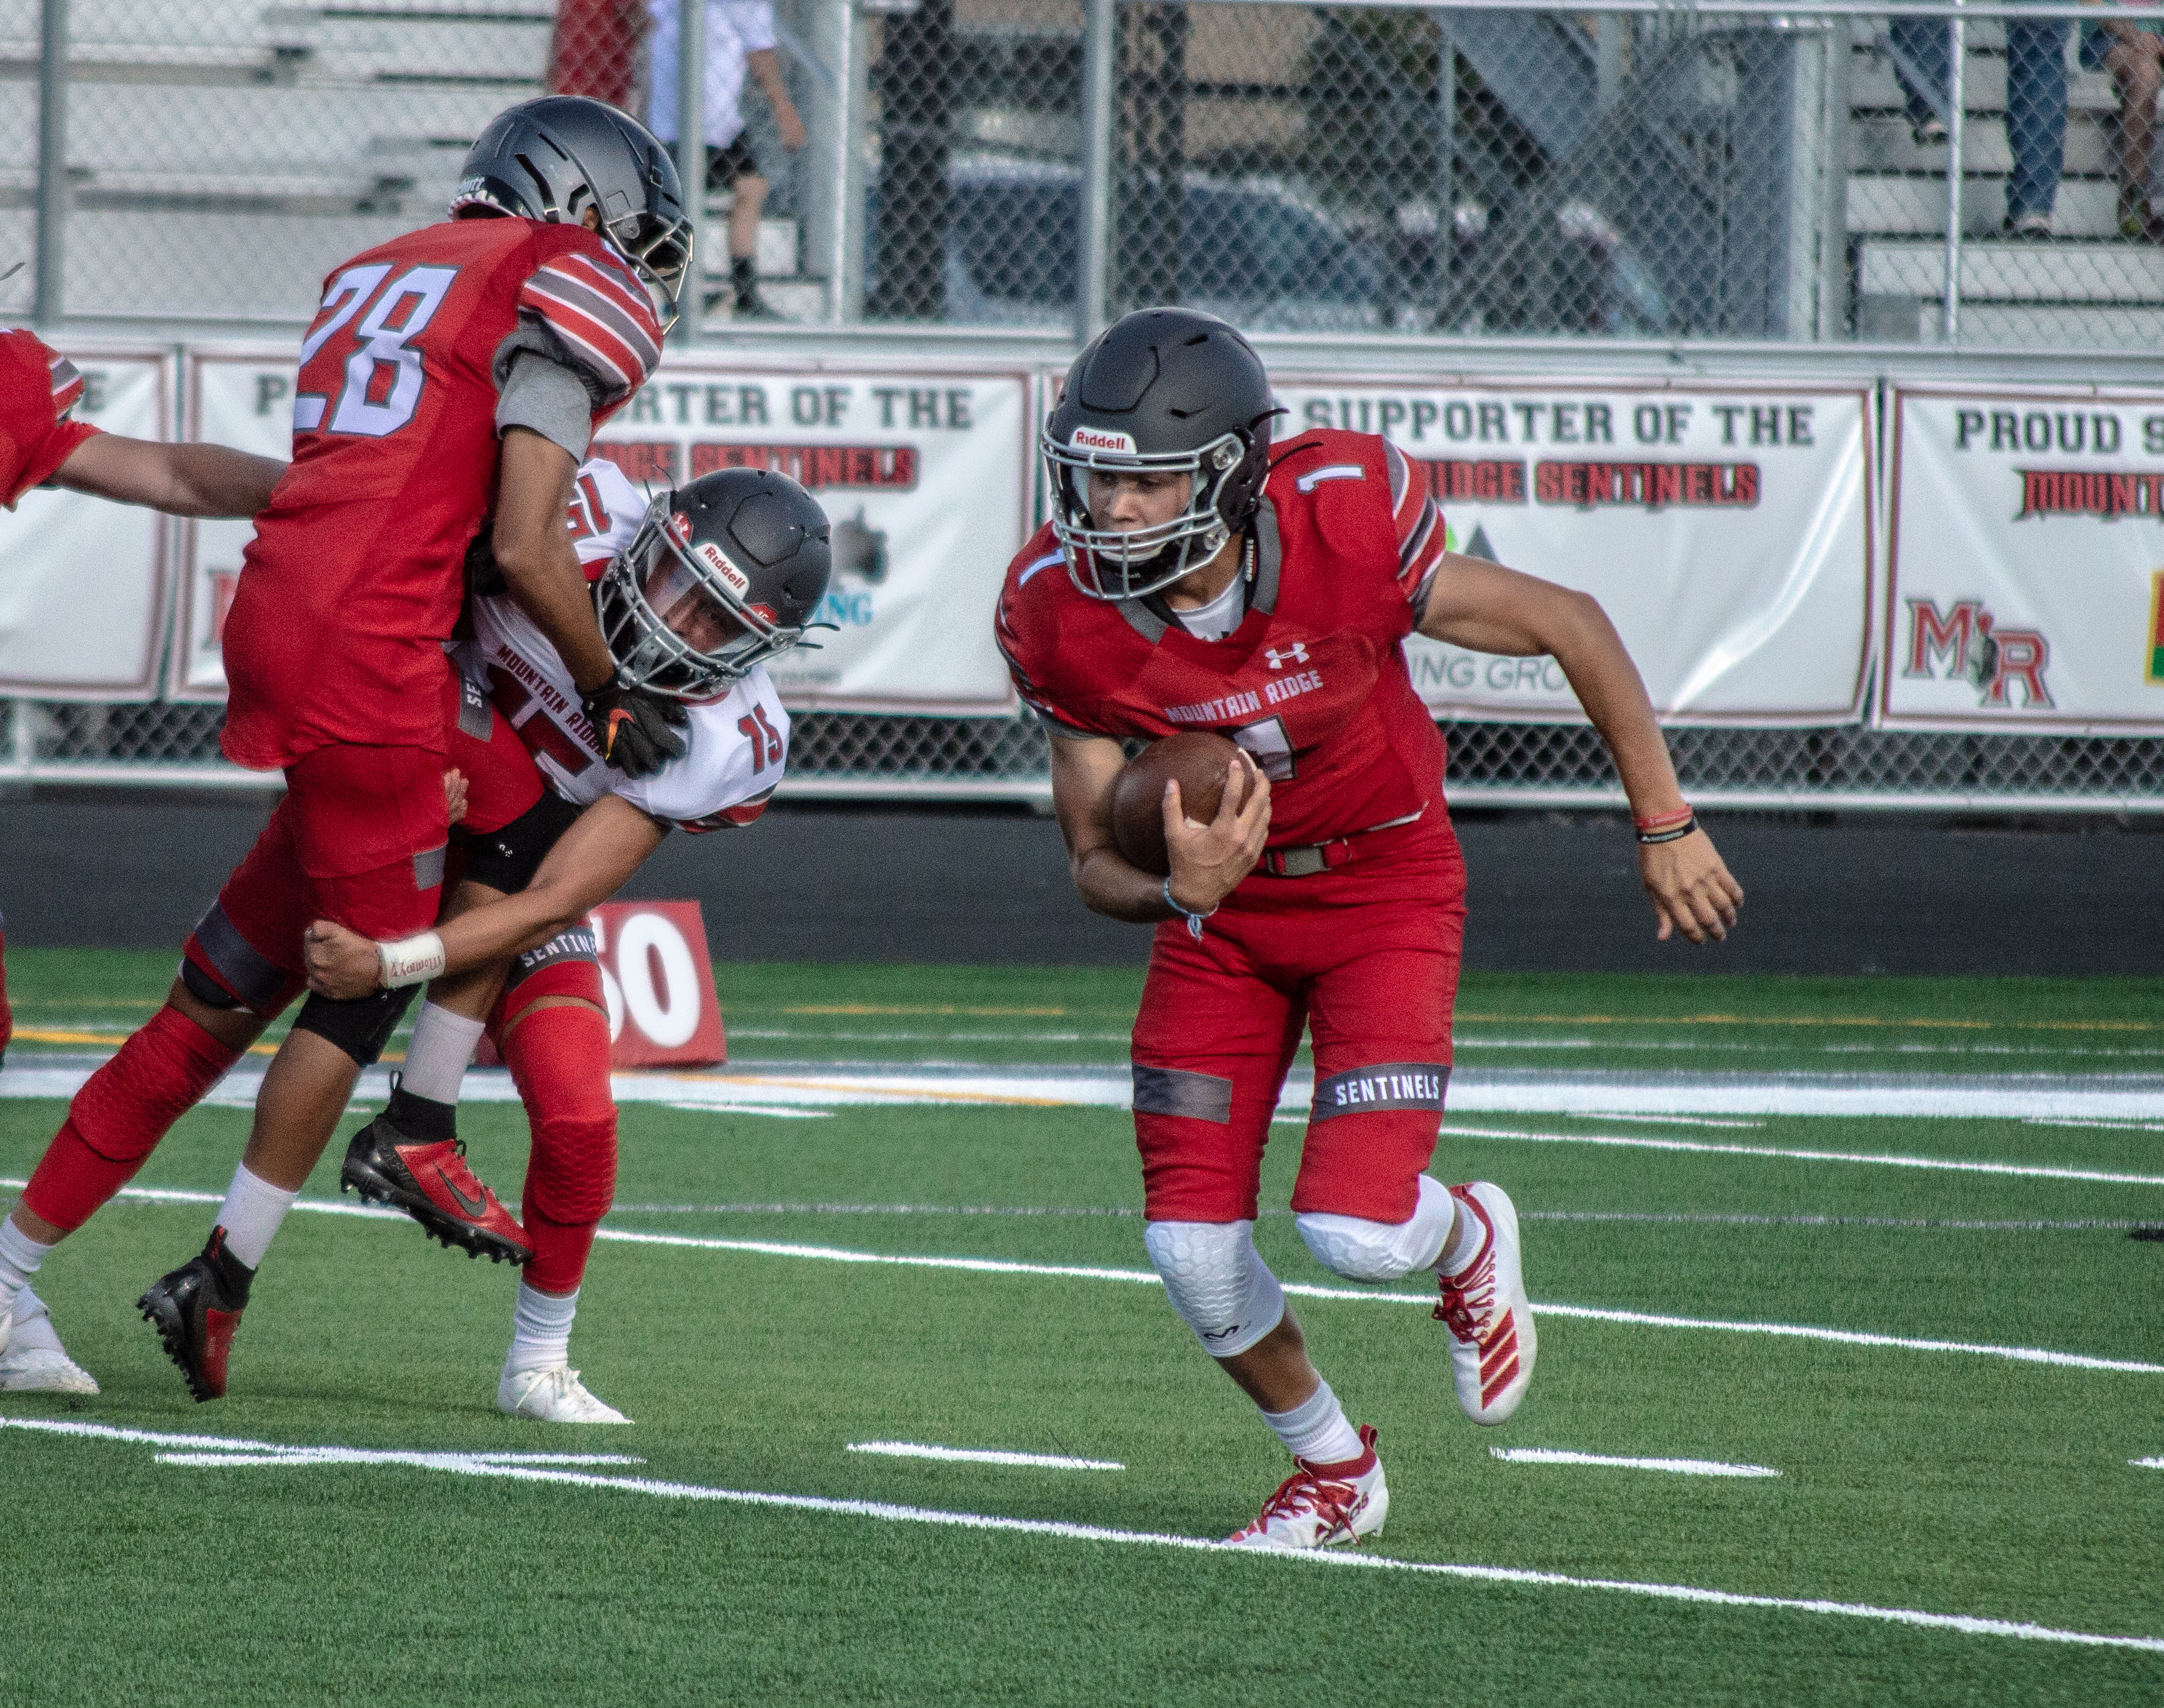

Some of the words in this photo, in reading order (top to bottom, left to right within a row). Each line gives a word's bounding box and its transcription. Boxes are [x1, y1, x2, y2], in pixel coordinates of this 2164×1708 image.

[293, 261, 463, 439] 28
[611, 383, 768, 425] RTER
[790, 383, 851, 427] OF
[872, 386, 973, 430] THE
[1302, 397, 1614, 442] SUPPORTER
[1633, 404, 1692, 444] OF
[1711, 404, 1813, 446] THE
[1954, 409, 2123, 453] PROUD
[1076, 431, 1126, 450] Riddell
[1418, 459, 1527, 502] IDGE
[1535, 461, 1763, 512] SENTINELS
[705, 546, 747, 589] Riddell
[497, 643, 570, 715] MOUNTAIN
[1165, 690, 1262, 723] MOUNTAIN
[1264, 670, 1324, 705] RIDGE
[737, 701, 783, 776] 15
[1334, 1075, 1439, 1106] SENTINELS
